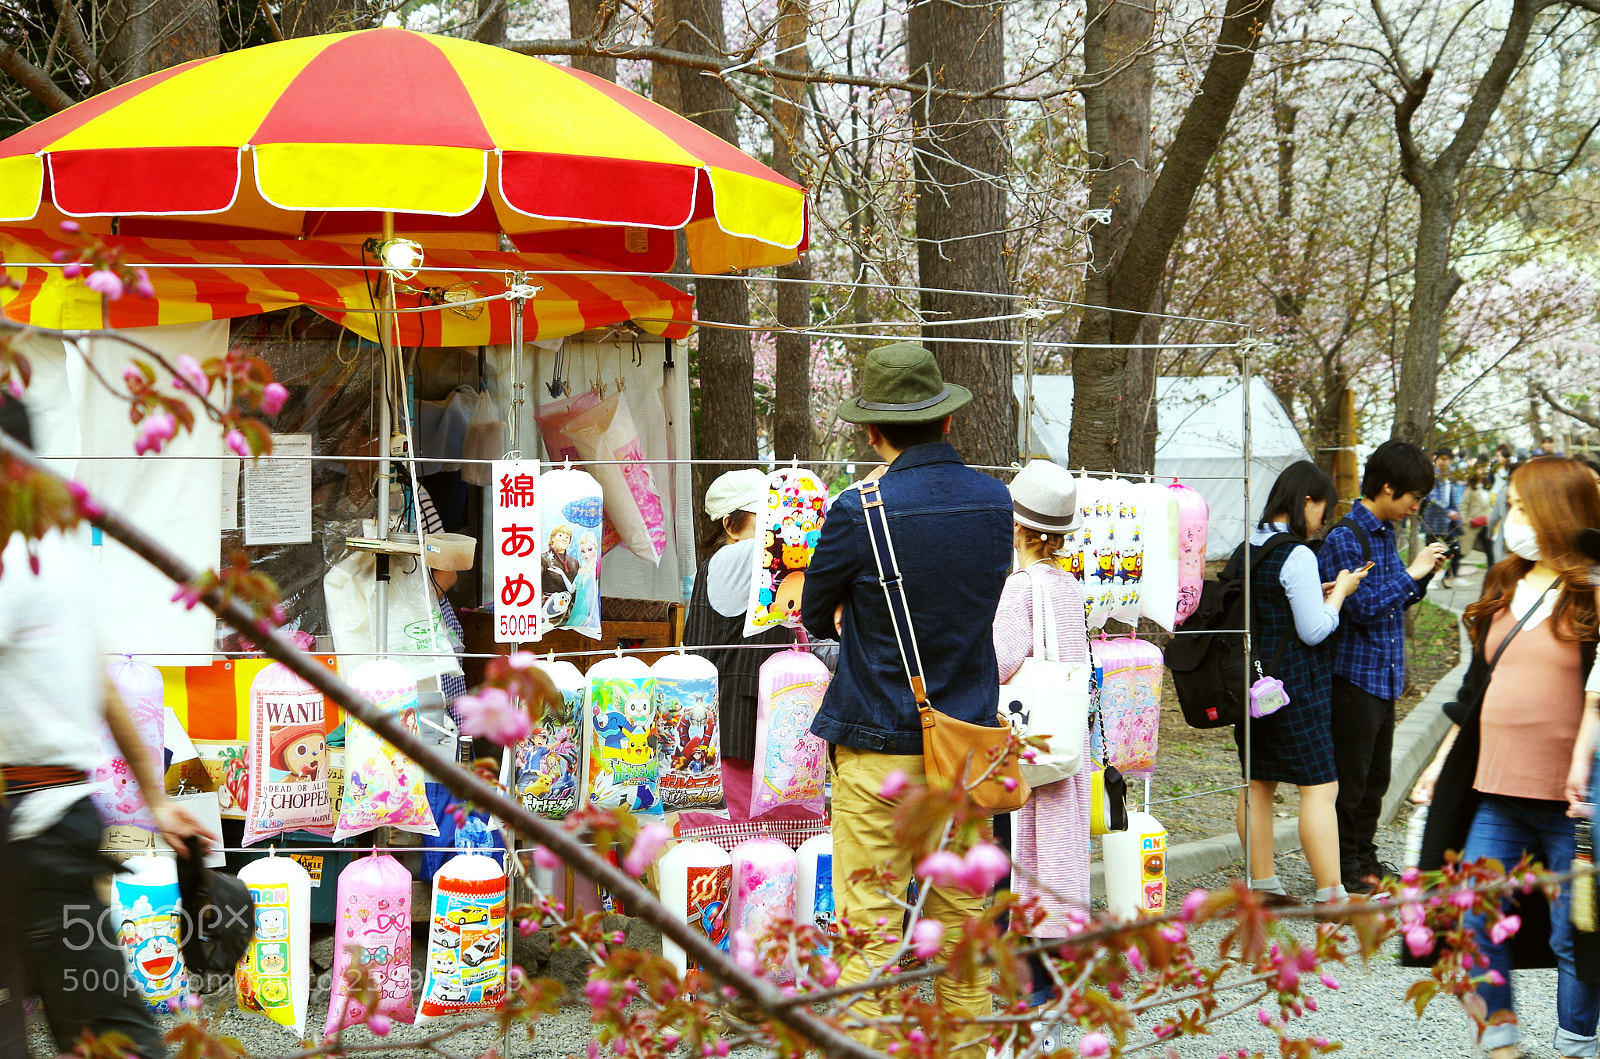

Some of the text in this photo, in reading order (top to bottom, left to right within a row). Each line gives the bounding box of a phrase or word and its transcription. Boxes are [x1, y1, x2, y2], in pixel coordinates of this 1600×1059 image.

[499, 472, 535, 608] 綿あめ
[500, 614, 537, 636] 500円
[268, 785, 292, 793] DEAD
[297, 784, 307, 792] OR
[271, 790, 329, 809] CHOPPER
